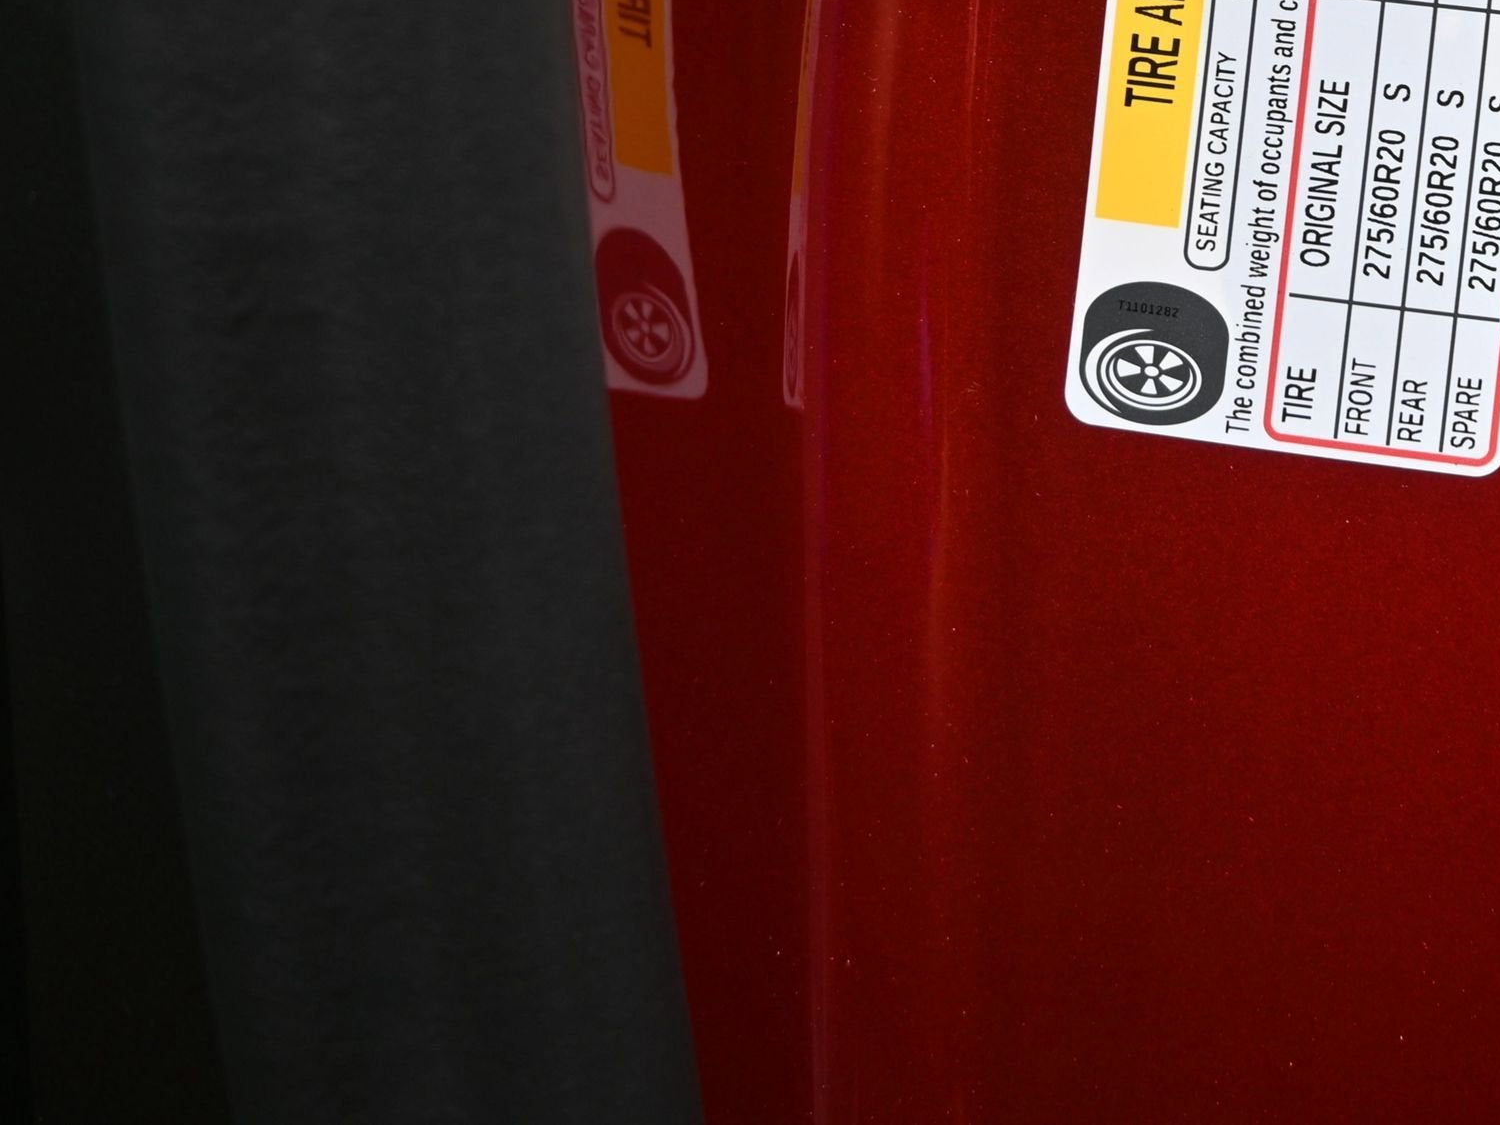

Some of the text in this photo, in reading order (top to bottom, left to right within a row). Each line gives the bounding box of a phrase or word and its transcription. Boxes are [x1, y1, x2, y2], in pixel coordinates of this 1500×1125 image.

[1124, 34, 1180, 107] TIRE
[1271, 19, 1296, 58] and
[1196, 52, 1236, 251] SEATING CAPACITY
[1261, 64, 1293, 174] occupants
[1252, 179, 1279, 202] of
[1300, 80, 1350, 267] ORIGINAL SIZE
[1363, 84, 1411, 279] 275/60R20 S
[1416, 90, 1464, 286] 275/60R20 S
[1246, 207, 1279, 277] weight
[1118, 299, 1181, 319] T1101282
[1235, 285, 1266, 389] combined
[1225, 397, 1253, 433] The
[1282, 366, 1317, 422] TIRE
[1344, 358, 1376, 435] FRONT
[1397, 380, 1427, 442] REAR
[1450, 377, 1482, 449] SPARE
